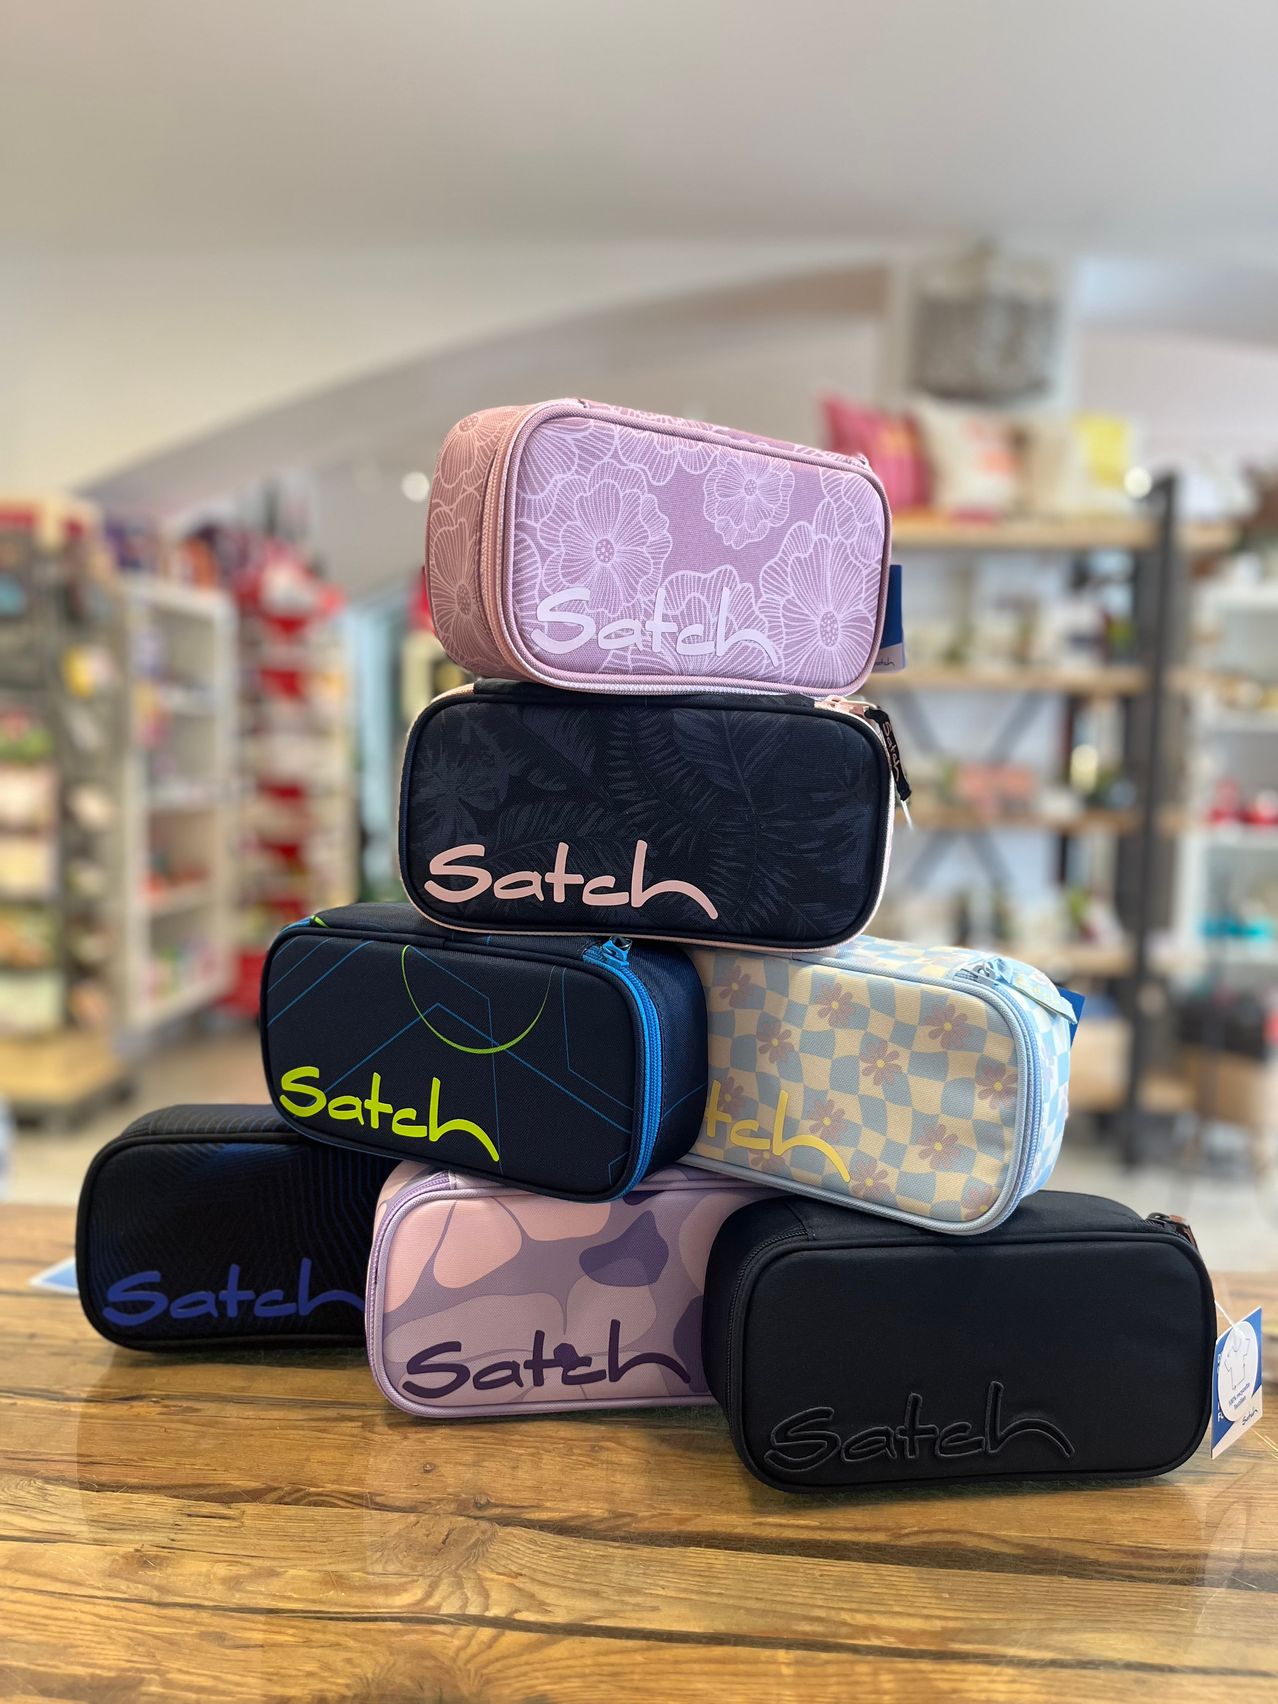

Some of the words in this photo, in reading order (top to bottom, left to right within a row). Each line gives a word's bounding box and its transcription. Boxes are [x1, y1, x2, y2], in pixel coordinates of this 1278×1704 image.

[531, 586, 779, 667] Satch
[874, 656, 896, 667] atch
[882, 721, 900, 782] Satch
[423, 839, 719, 920] Satch
[279, 1065, 500, 1162] Satch
[704, 1079, 851, 1183] tch
[102, 1257, 366, 1327] Satch
[402, 1319, 691, 1399] Satch
[763, 1380, 1076, 1471] Satch
